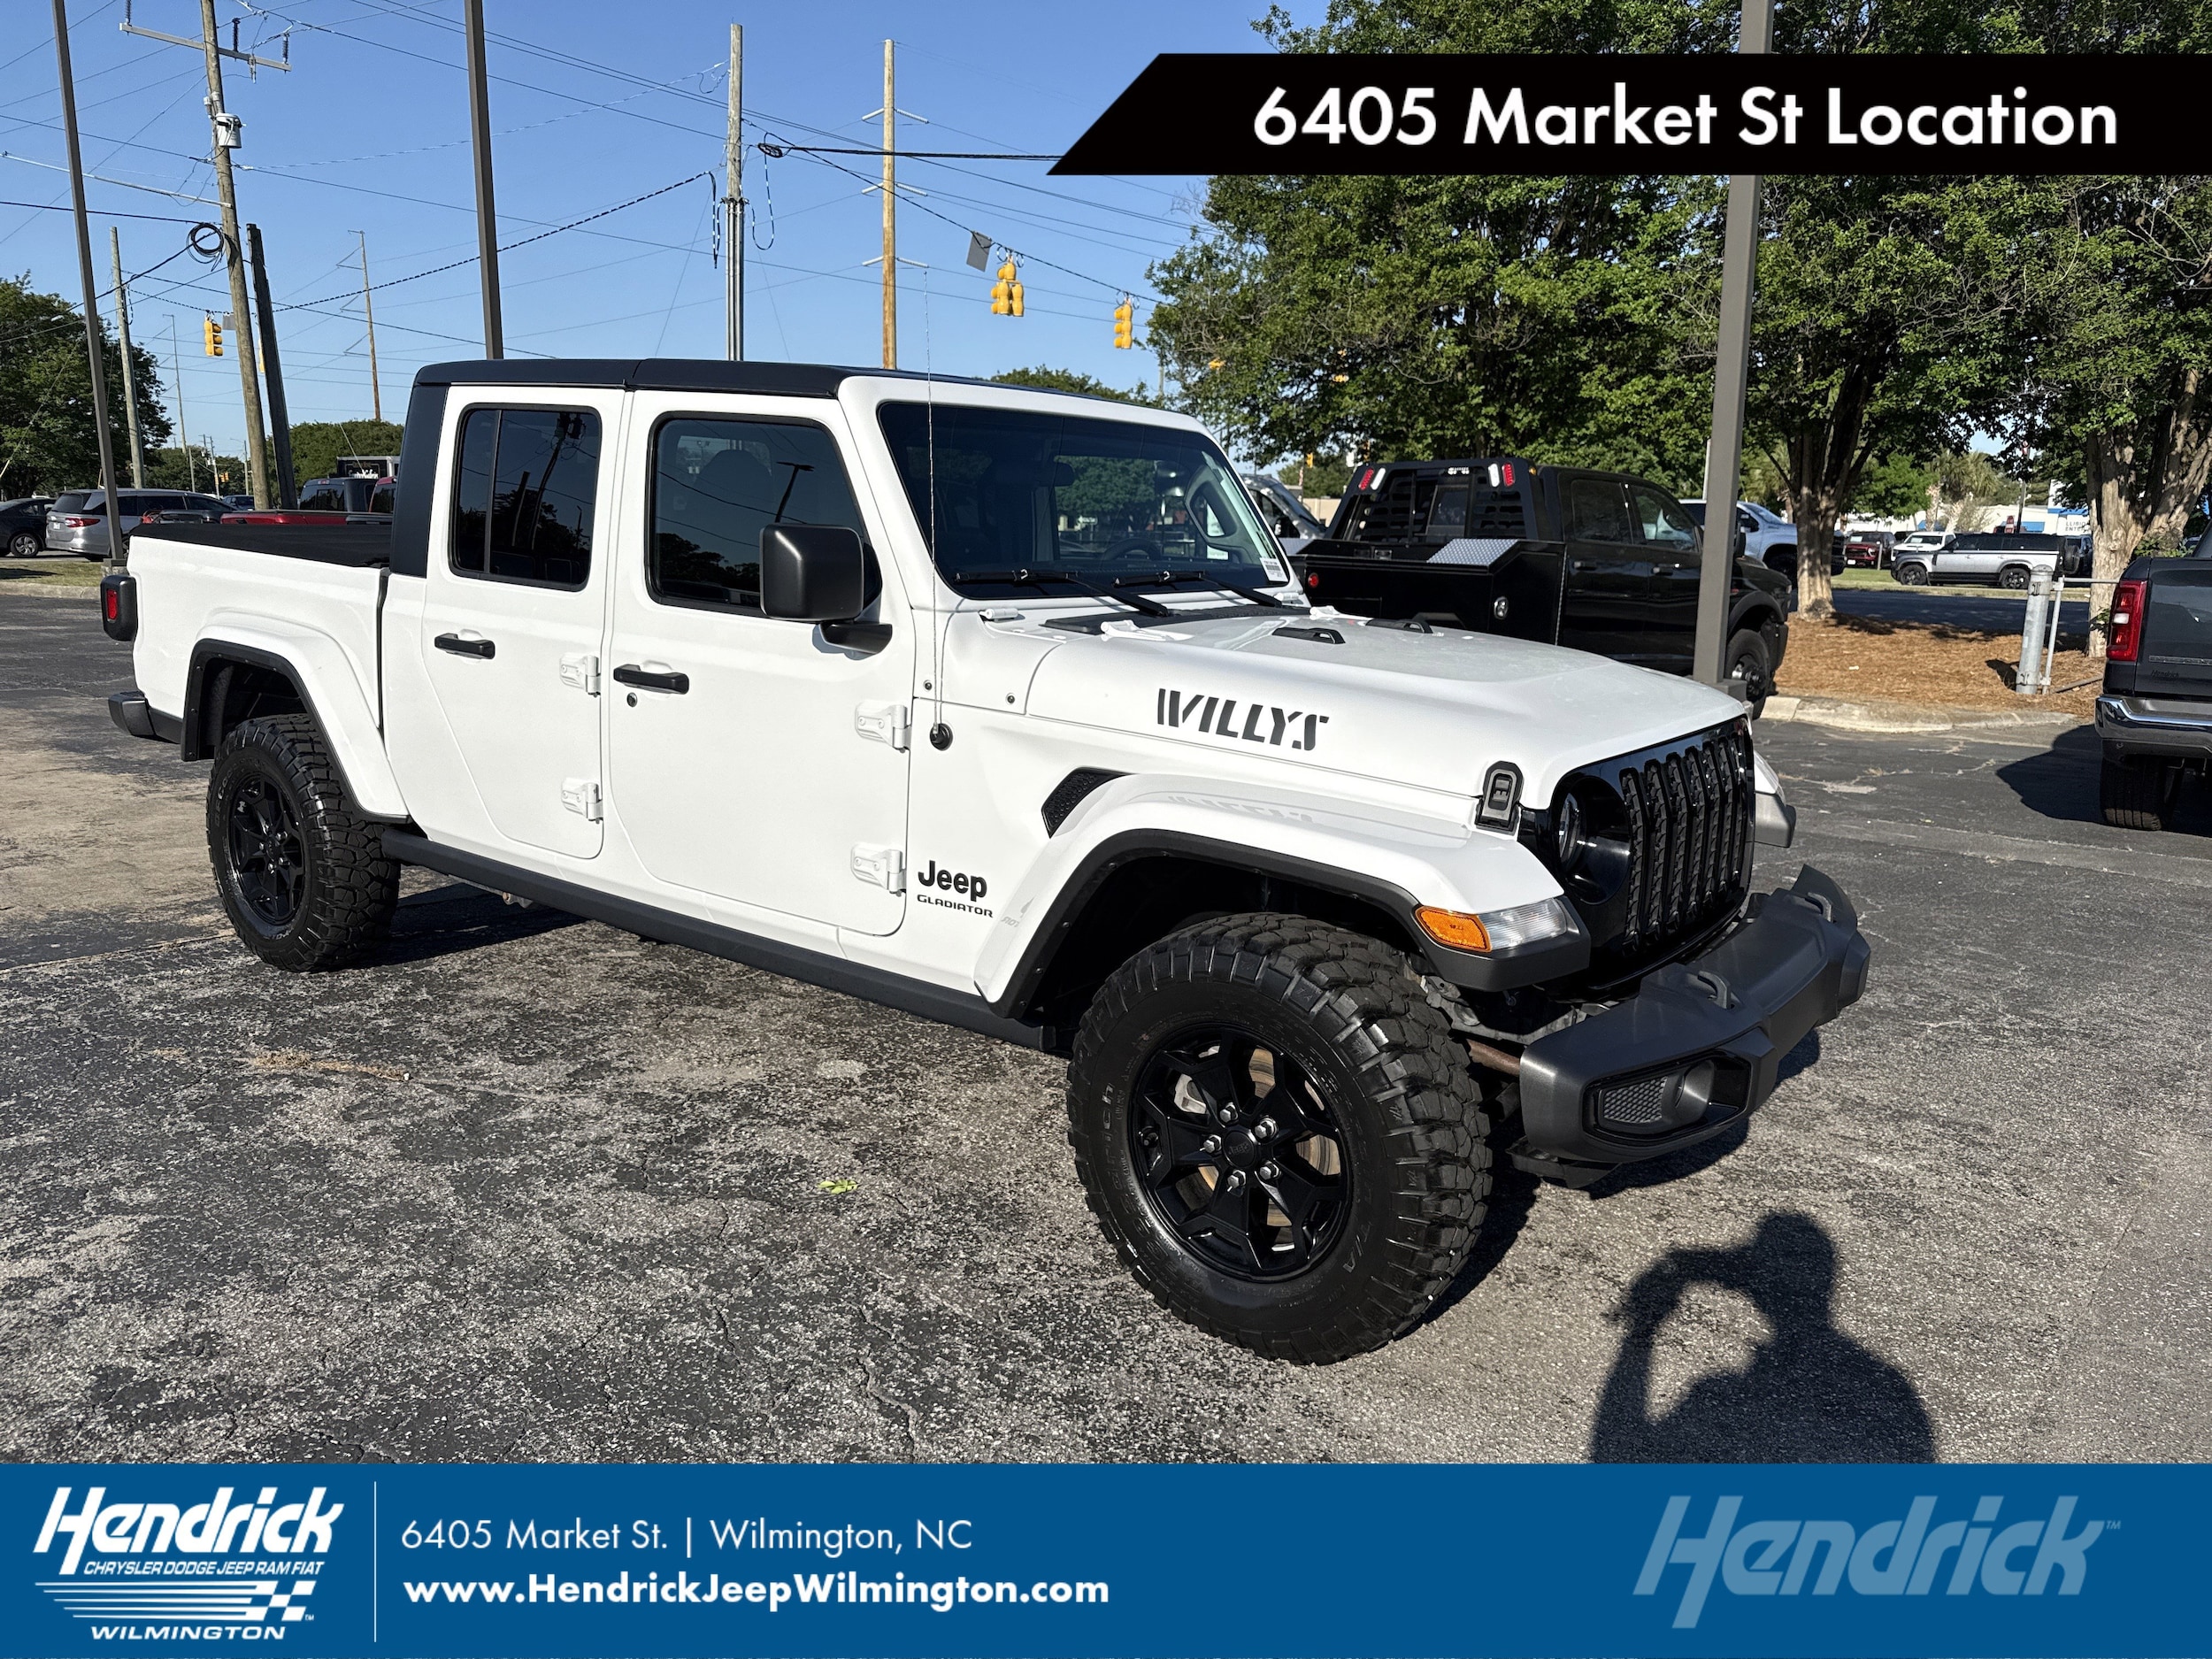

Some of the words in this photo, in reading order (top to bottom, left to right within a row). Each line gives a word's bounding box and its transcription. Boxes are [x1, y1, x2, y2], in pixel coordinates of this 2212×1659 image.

[1157, 688, 1330, 751] WILLYS
[918, 860, 987, 902] Jeep
[917, 894, 993, 918] GLADIATOR
